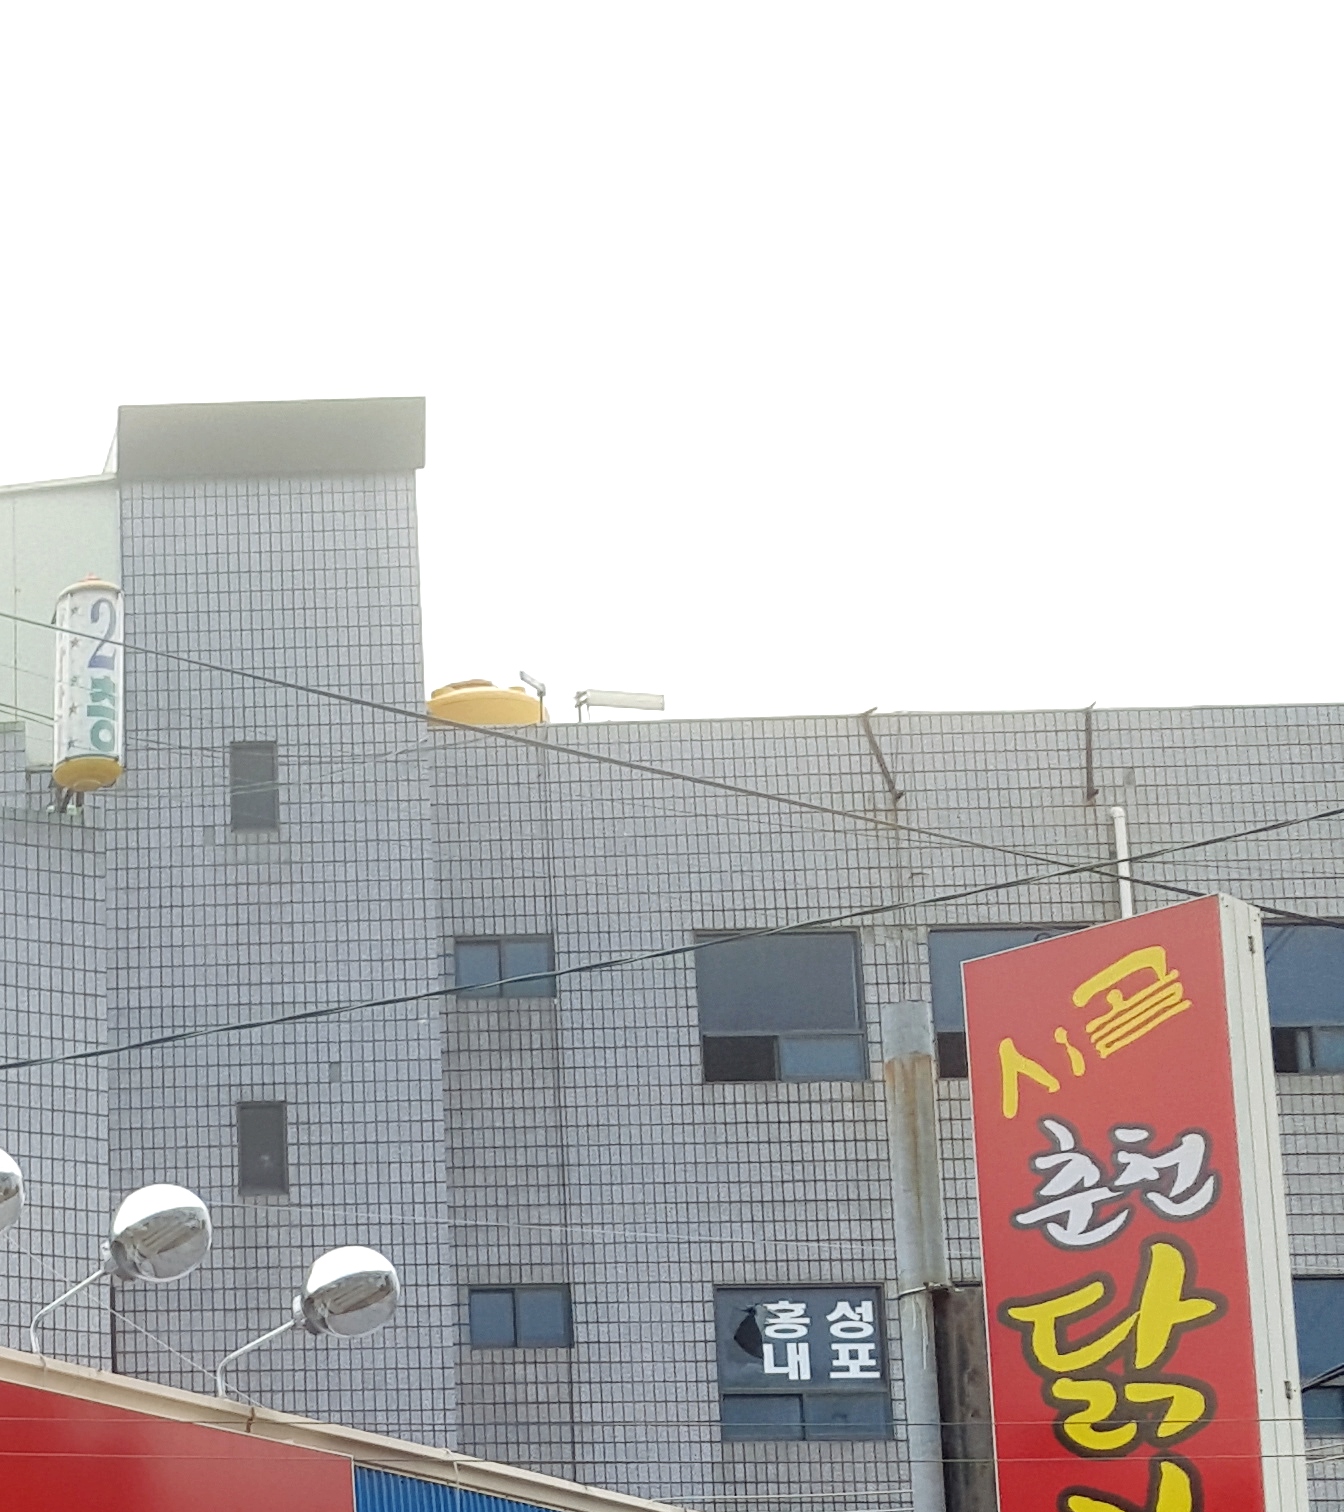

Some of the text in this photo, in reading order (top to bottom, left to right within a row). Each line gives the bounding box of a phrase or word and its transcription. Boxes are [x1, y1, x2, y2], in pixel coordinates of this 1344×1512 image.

[998, 945, 1192, 1119] 시골
[1012, 1116, 1218, 1248] 춘천
[762, 1300, 875, 1339] 홍성
[762, 1343, 881, 1381] 내포
